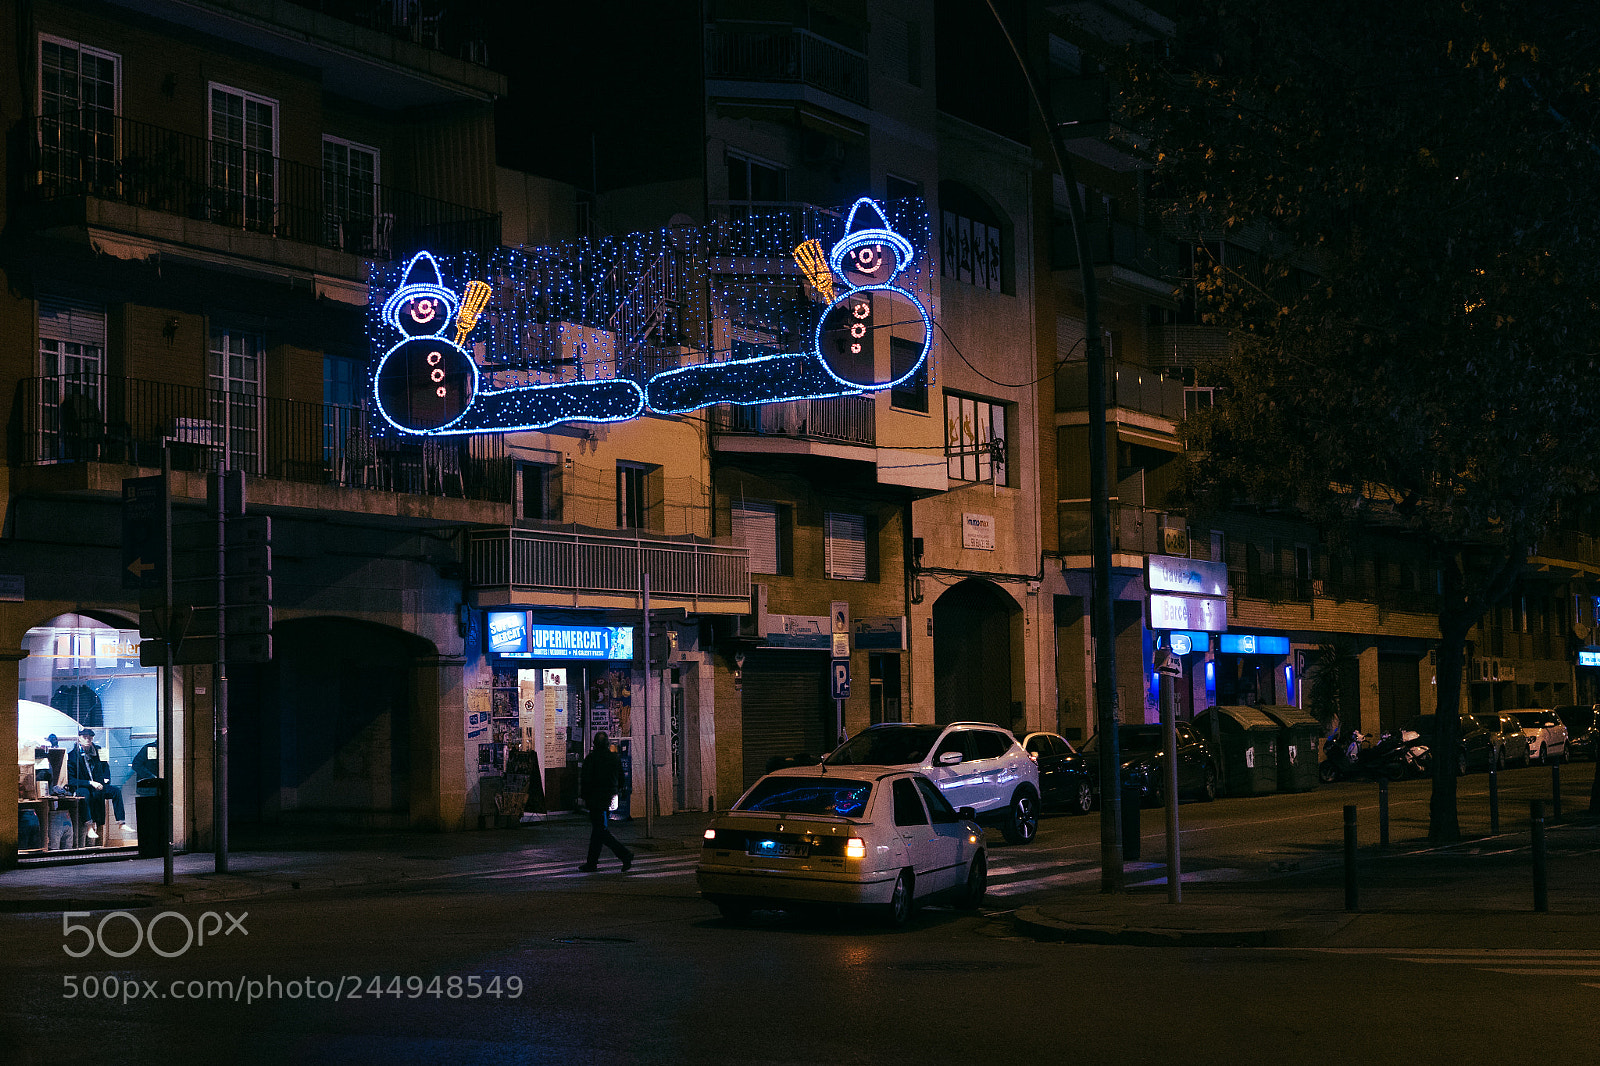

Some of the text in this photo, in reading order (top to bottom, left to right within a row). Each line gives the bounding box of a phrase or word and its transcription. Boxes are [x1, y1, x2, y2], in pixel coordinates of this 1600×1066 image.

[489, 615, 519, 635] SUPER
[491, 626, 526, 646] MERCAT 1
[533, 629, 609, 649] SUPERMERCAT 1
[835, 665, 847, 694] P
